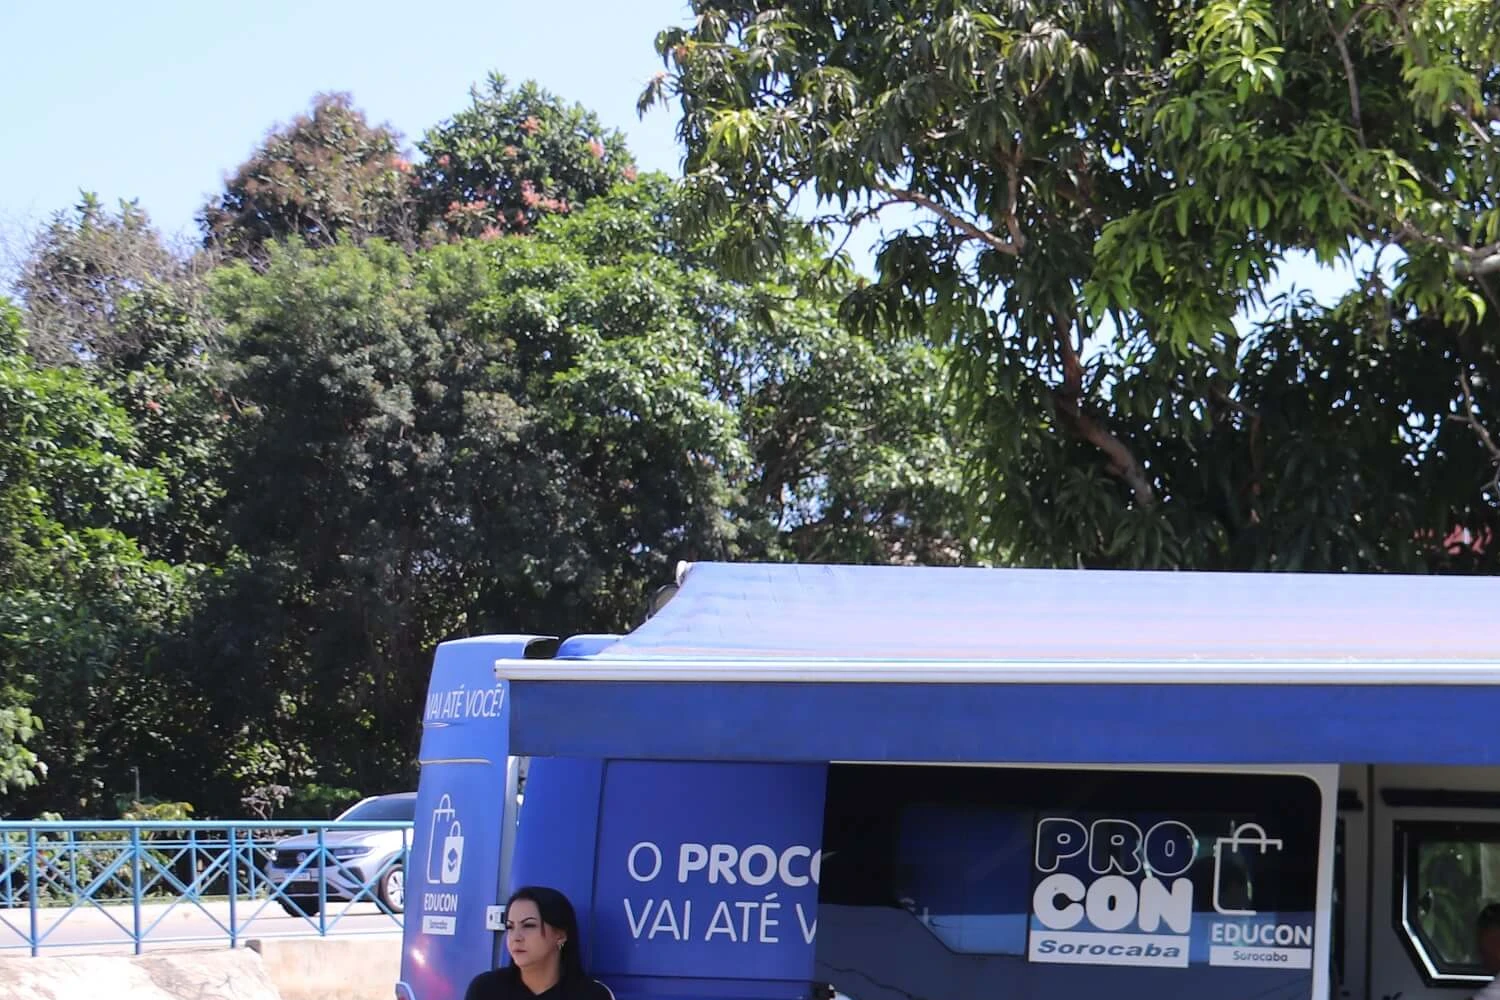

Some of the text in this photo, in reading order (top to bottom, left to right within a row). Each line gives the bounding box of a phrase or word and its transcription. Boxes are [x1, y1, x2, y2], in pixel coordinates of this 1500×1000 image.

[441, 684, 465, 718] ATÉ
[465, 682, 505, 717] VOCÊ!
[627, 841, 822, 887] O PROC
[1035, 817, 1197, 877] PRO
[424, 893, 458, 912] EDUCON
[623, 898, 690, 939] VAI
[704, 892, 780, 943] ATÉ
[1032, 873, 1194, 933] CON
[1037, 939, 1181, 959] Sorocaba
[1211, 922, 1313, 946] EDUCON
[1232, 950, 1288, 963] Sorocaba
